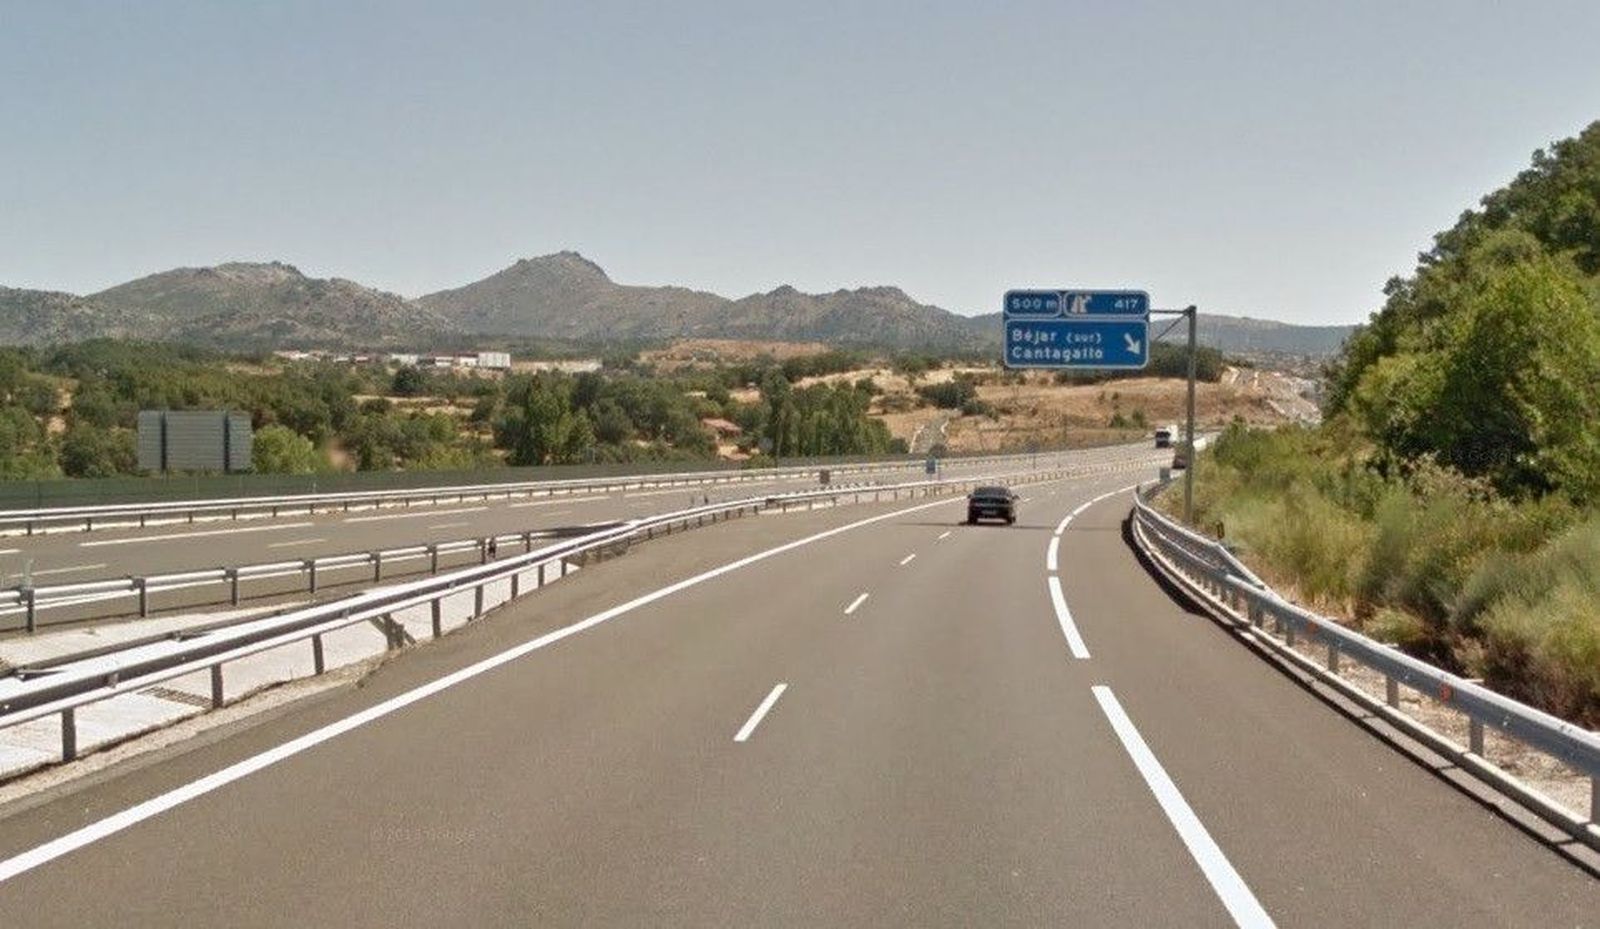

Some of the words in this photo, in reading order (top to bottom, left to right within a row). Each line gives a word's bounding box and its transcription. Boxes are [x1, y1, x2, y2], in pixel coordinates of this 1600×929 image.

[1012, 298, 1042, 309] 500
[1046, 299, 1059, 309] m
[1114, 298, 1139, 309] 417
[1012, 346, 1104, 362] Cantagallo
